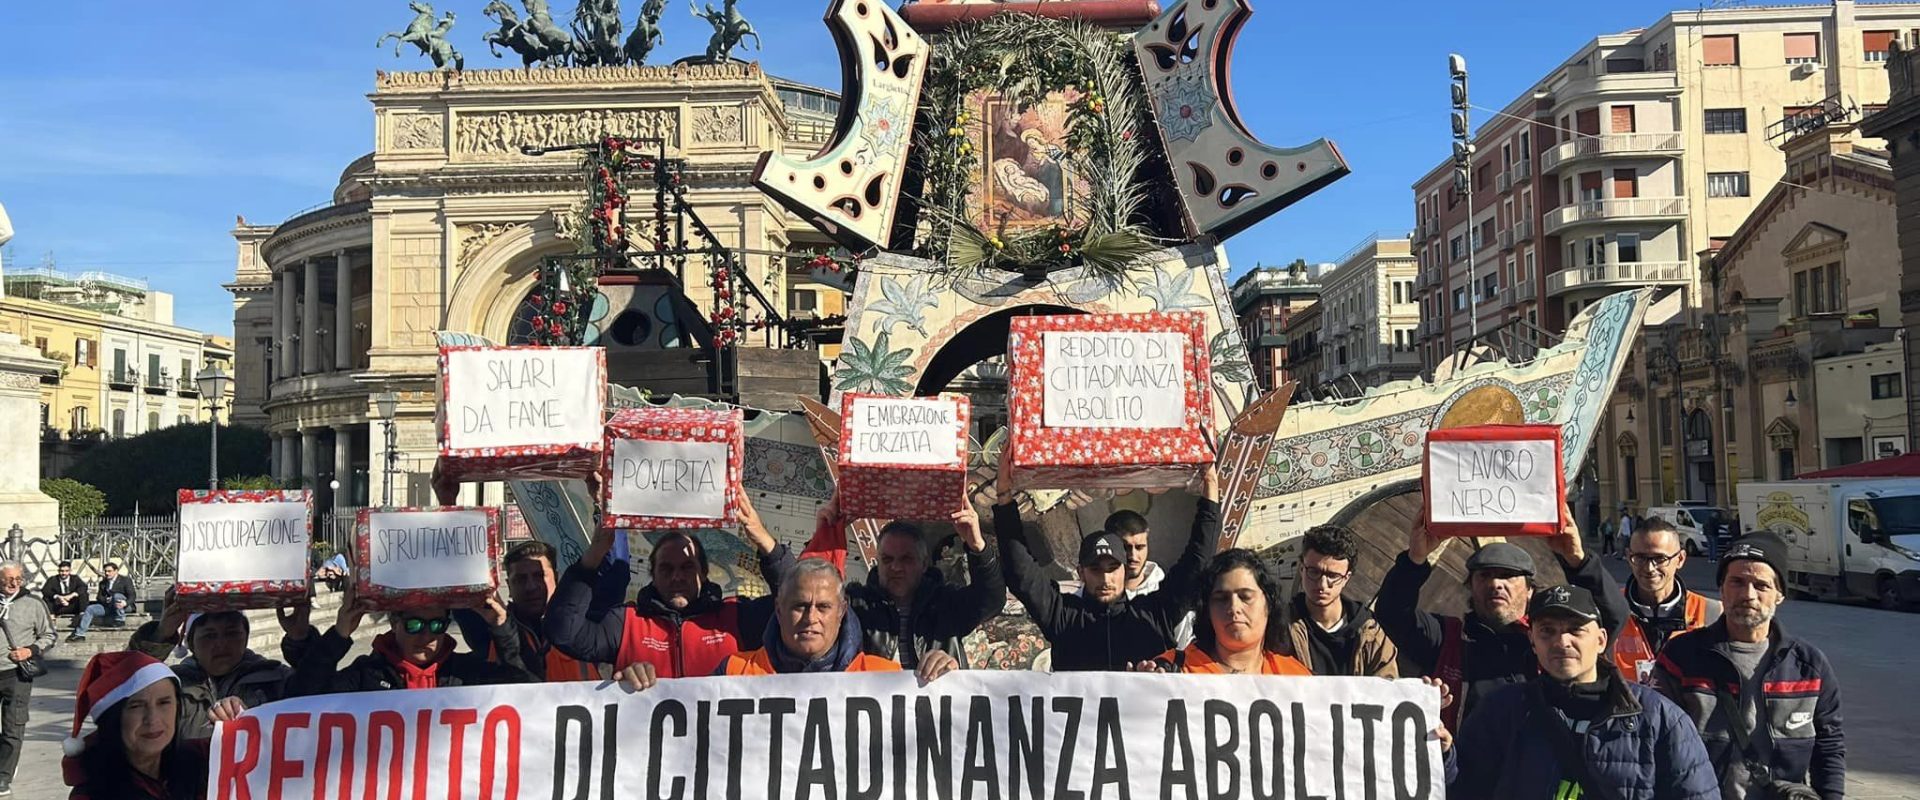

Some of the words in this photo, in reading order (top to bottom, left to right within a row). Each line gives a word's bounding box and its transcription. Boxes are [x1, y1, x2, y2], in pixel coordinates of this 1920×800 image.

[1059, 336, 1135, 358] REDDITO
[1146, 338, 1167, 359] DI
[486, 357, 556, 391] SALARI
[1050, 363, 1180, 391] CITTADINANZA
[463, 404, 494, 434] DA
[509, 399, 565, 430] FAME
[867, 404, 951, 427] EMIGRAZIONE
[1063, 396, 1143, 421] ABOLITO
[860, 429, 932, 453] FORZATA
[621, 457, 716, 492] POVERTÀ
[1457, 448, 1534, 482] LAVORO
[1451, 485, 1516, 517] NERO
[181, 518, 301, 553] DISOCCUPAZIONE
[377, 525, 487, 564] SFRUTTAMENTO
[215, 703, 522, 800] REDDITO
[551, 703, 618, 800] DI
[646, 694, 1130, 800] CITTADINANZA
[1159, 698, 1432, 800] ABOLITO
